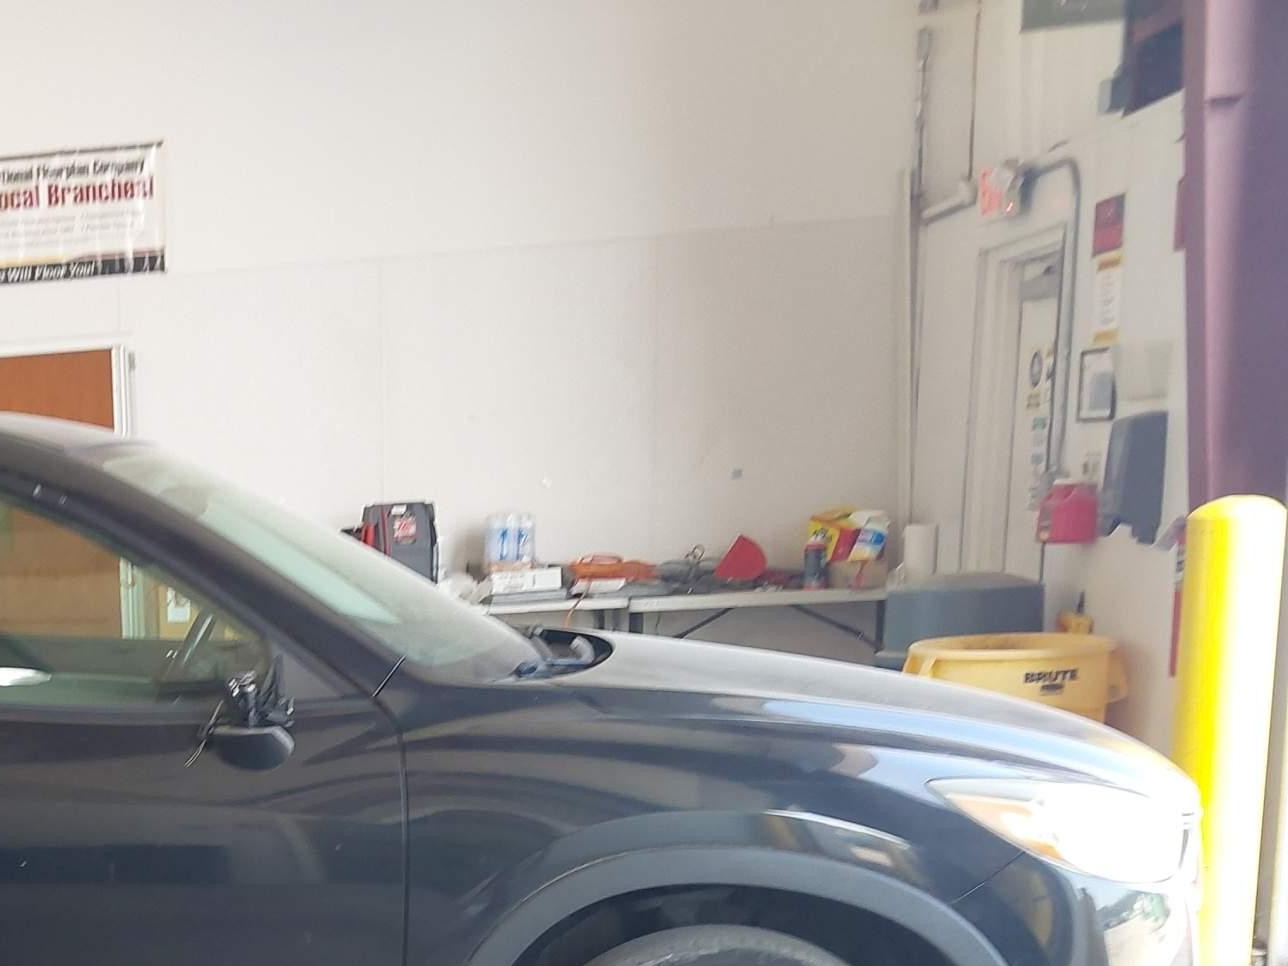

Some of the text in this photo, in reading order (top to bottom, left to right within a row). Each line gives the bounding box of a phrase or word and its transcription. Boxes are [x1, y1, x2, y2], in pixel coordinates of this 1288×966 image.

[37, 161, 89, 181] Floorplan
[93, 158, 145, 177] Company
[7, 265, 33, 283] Will
[1024, 668, 1079, 684] BRUTE
